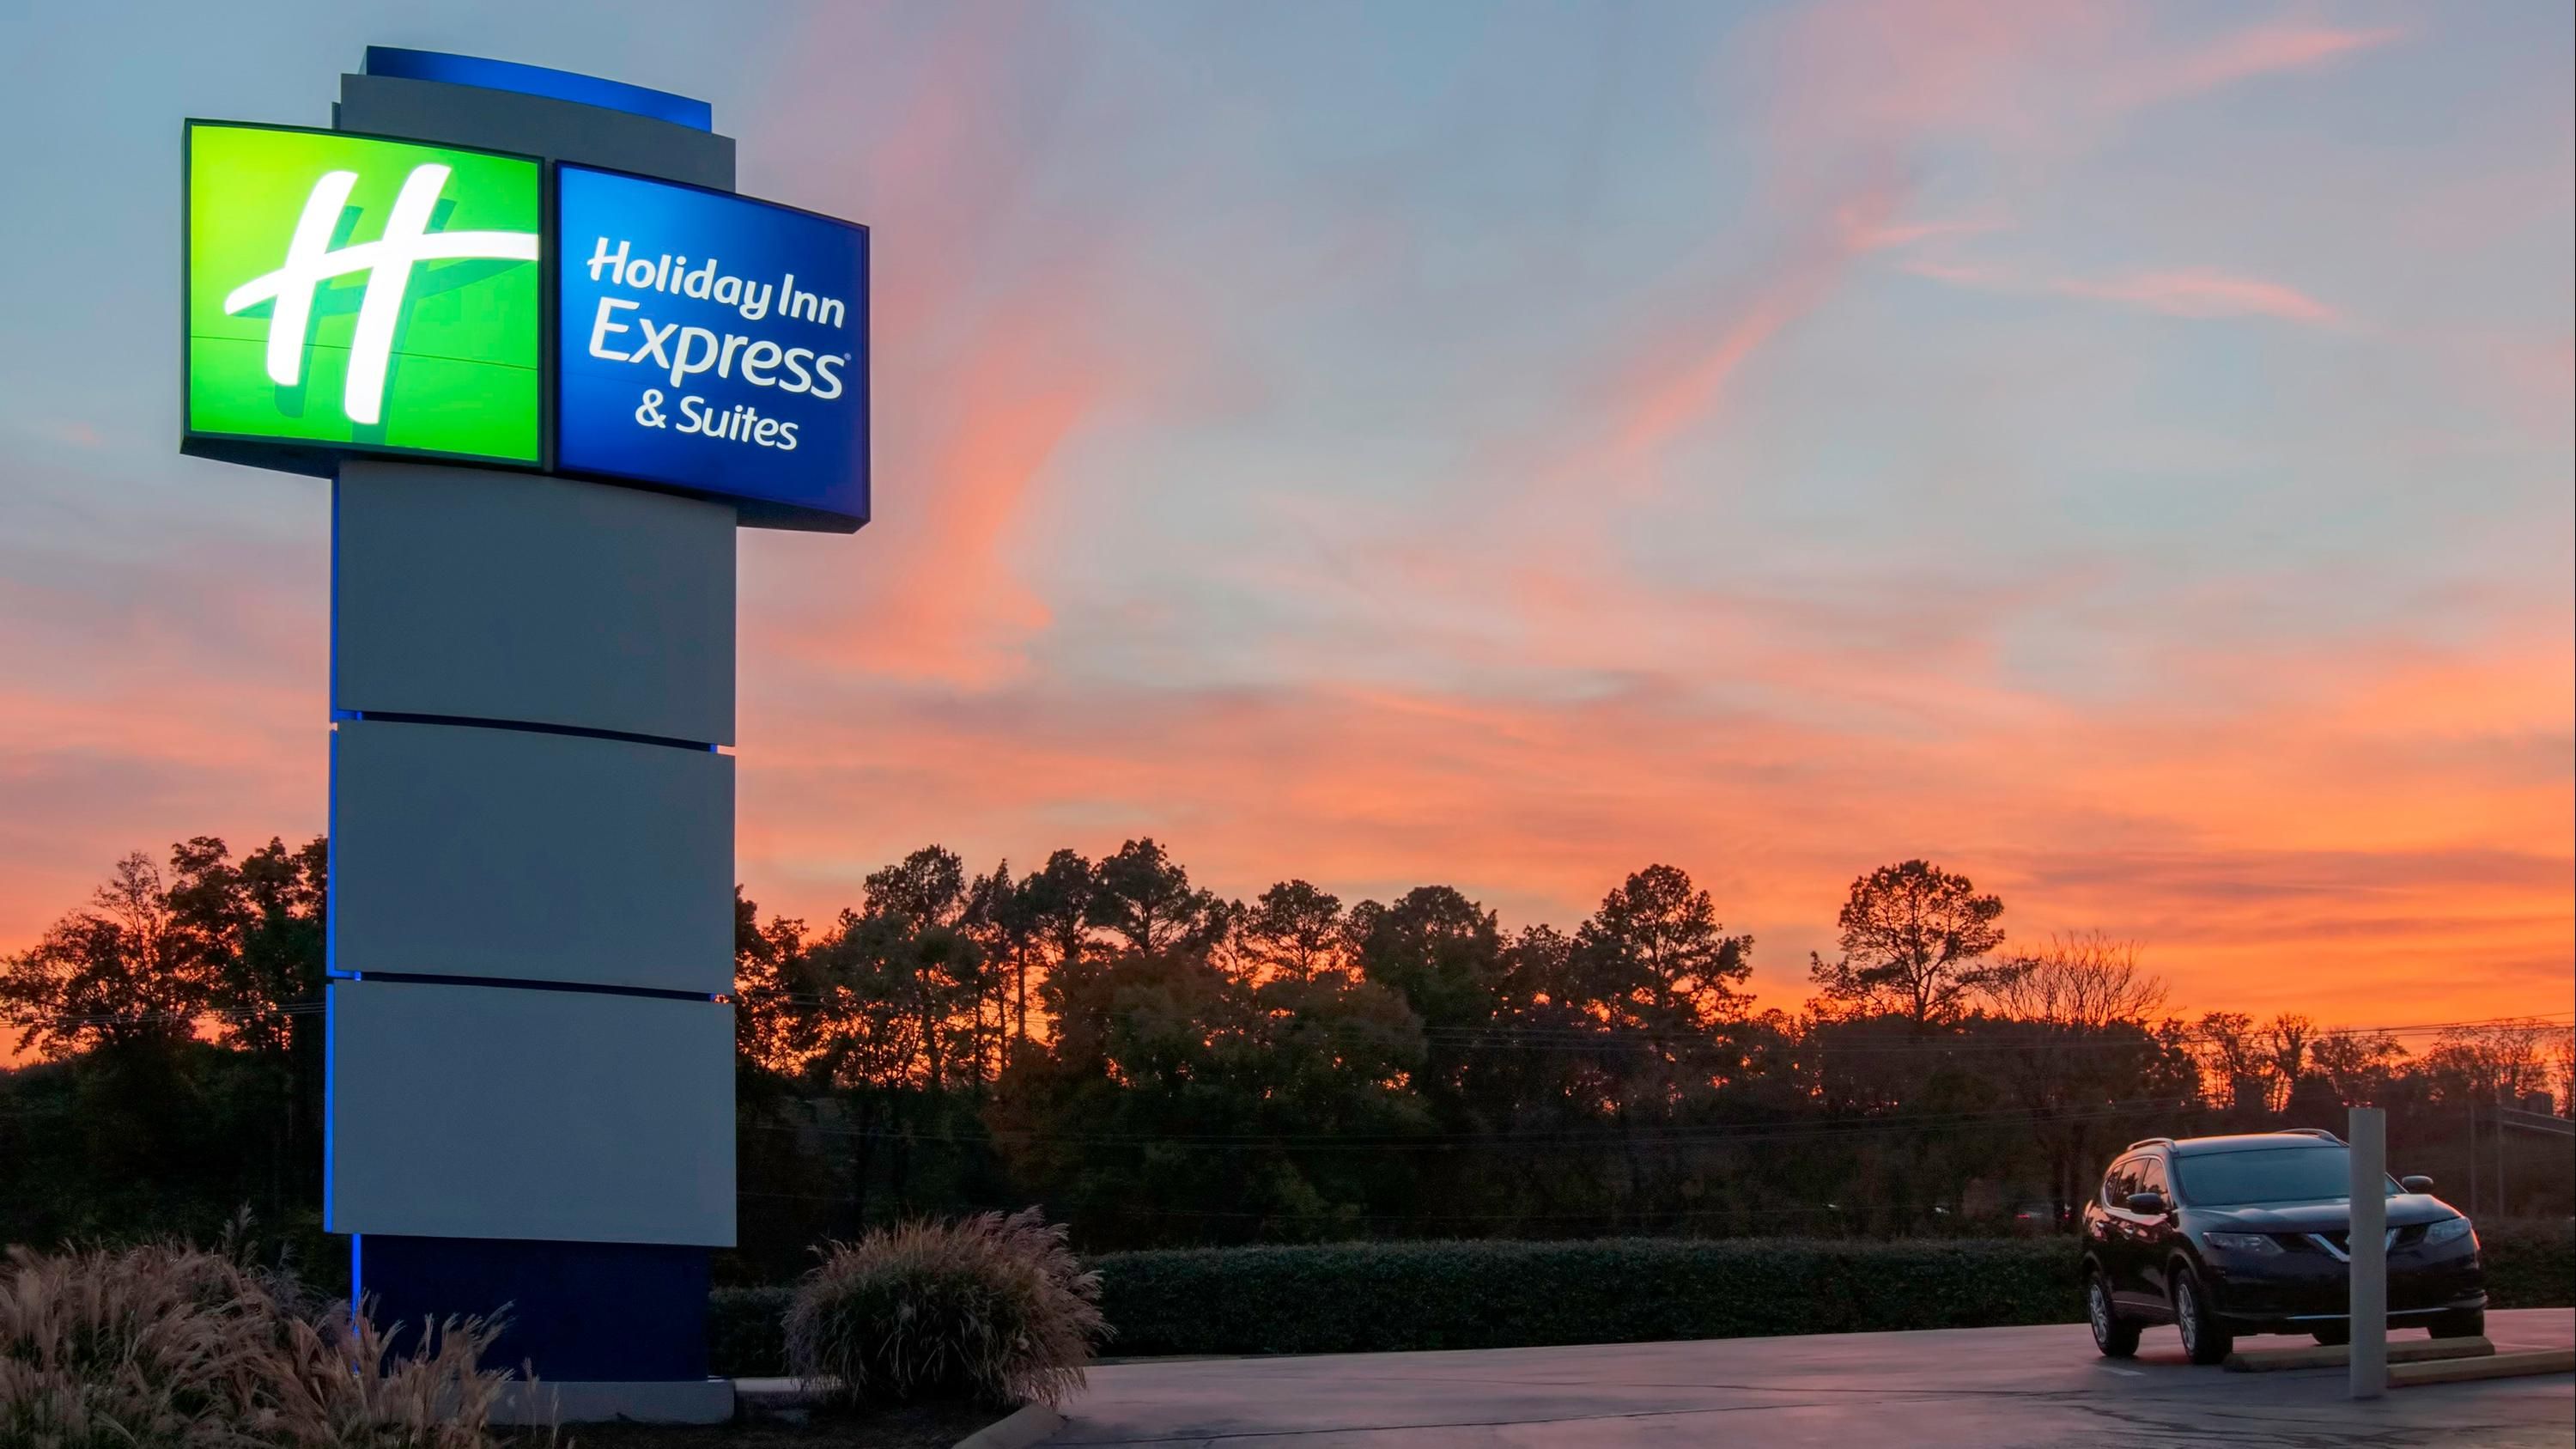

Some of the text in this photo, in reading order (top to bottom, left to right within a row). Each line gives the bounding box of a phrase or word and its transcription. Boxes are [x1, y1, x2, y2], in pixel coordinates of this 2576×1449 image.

[224, 163, 538, 424] H
[586, 236, 846, 329] Holiday Inn
[589, 296, 846, 399] Express
[635, 388, 799, 451] & Suites
